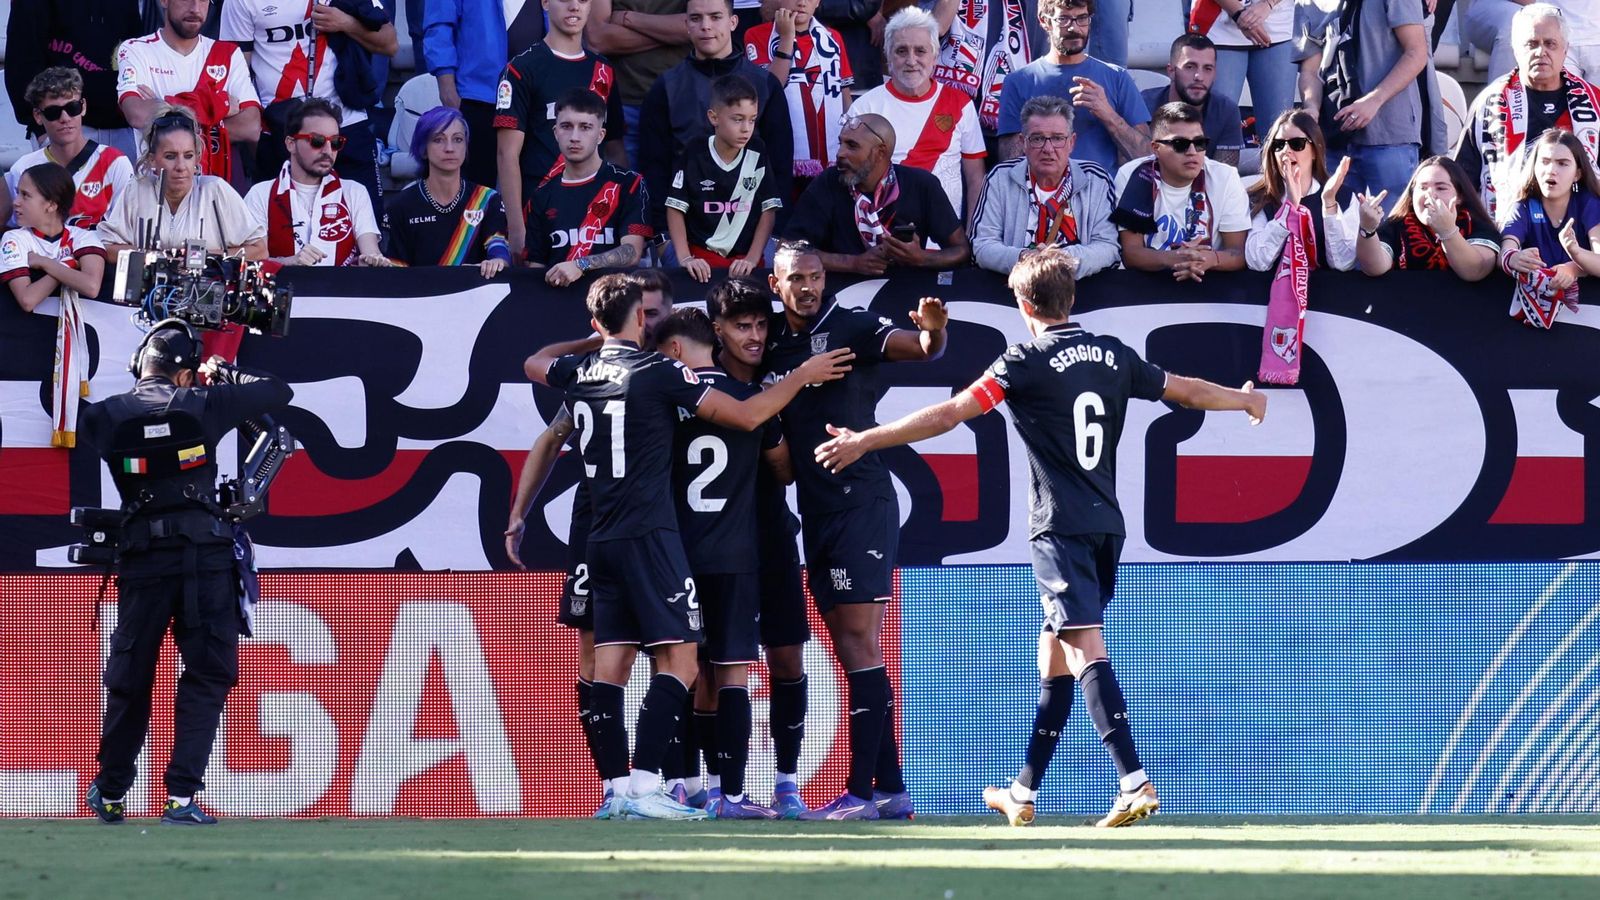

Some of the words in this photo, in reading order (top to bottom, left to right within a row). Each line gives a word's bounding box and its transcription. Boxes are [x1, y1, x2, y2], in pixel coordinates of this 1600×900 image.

[149, 66, 175, 76] KELME
[935, 67, 977, 86] RAYO
[1482, 94, 1507, 165] RAYO
[409, 216, 437, 224] KELME
[552, 227, 615, 248] DIGI
[1050, 344, 1103, 373] SERGIO
[1105, 350, 1119, 371] G.
[573, 400, 626, 478] 21
[1073, 391, 1106, 471] 6
[686, 435, 729, 512] 2
[574, 563, 590, 596] 2
